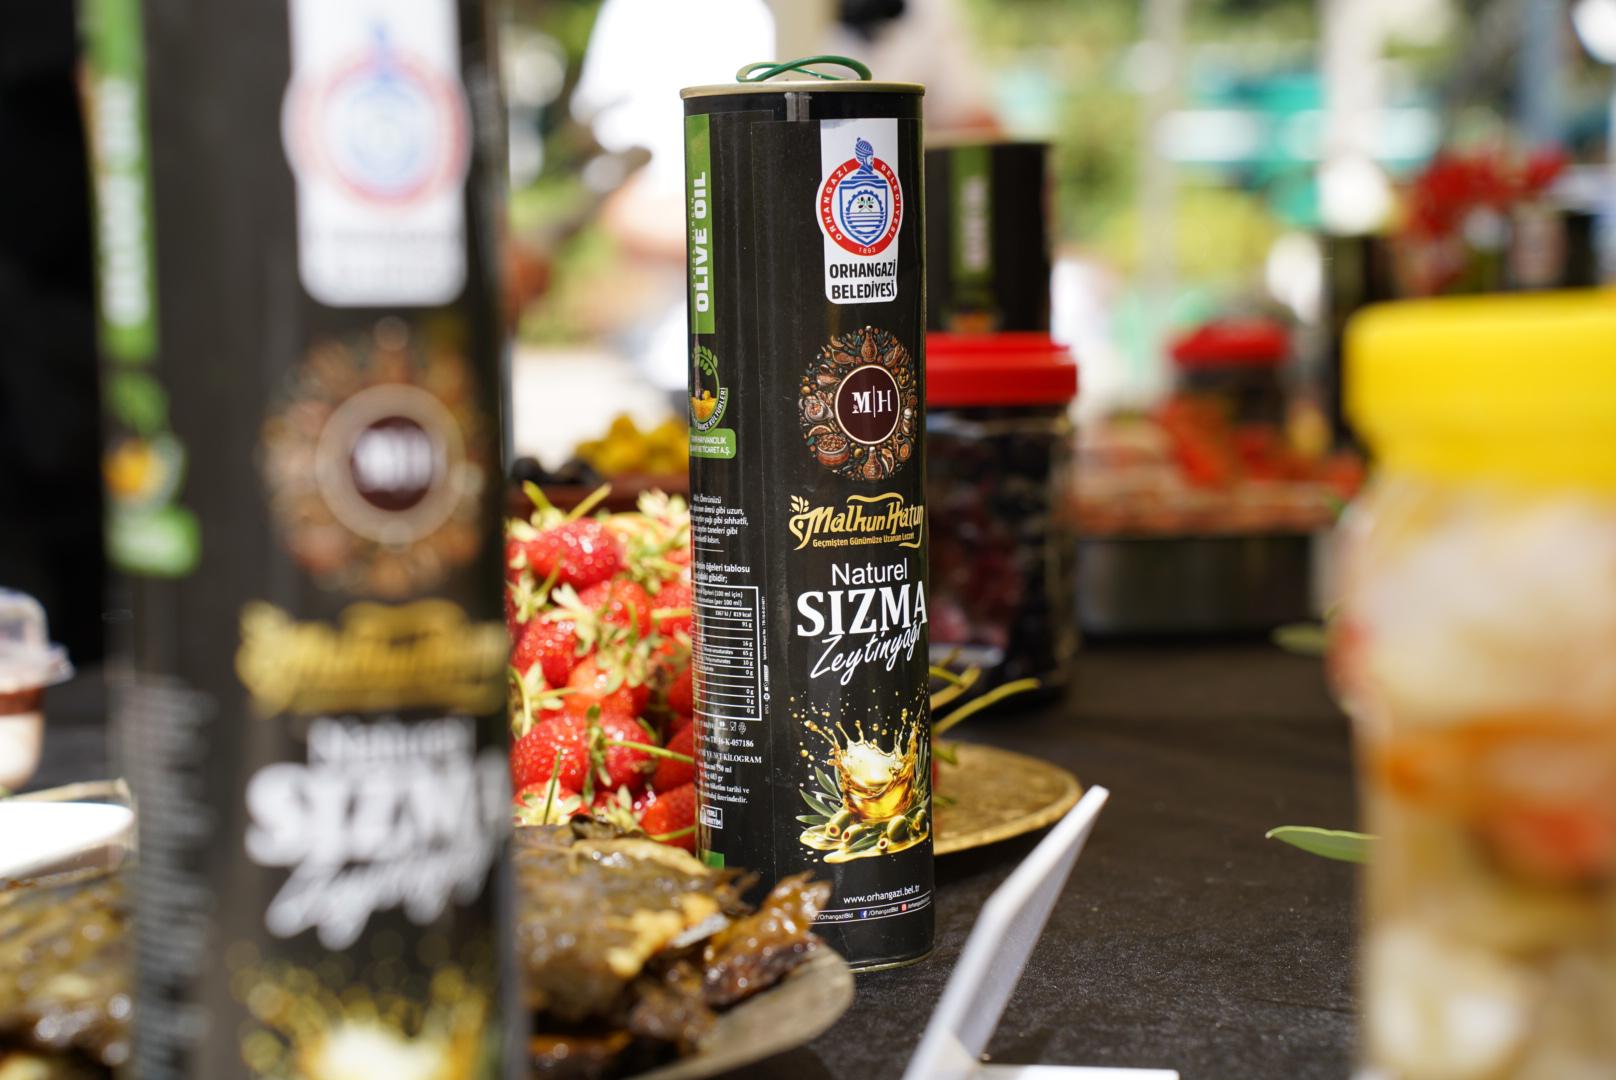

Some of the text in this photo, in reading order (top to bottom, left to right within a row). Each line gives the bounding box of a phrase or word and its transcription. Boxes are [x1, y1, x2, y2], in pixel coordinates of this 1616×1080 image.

[694, 171, 709, 313] OLIVE OIL
[829, 259, 896, 279] ORHANGAZİ
[831, 279, 896, 300] BELEDİYESİ
[726, 508, 744, 516] uzun,
[726, 527, 738, 537] gibi
[812, 538, 848, 549] Geçmişten
[849, 536, 883, 546] Günümüze
[724, 563, 751, 573] tablosu
[831, 557, 908, 586] Naturel
[796, 580, 928, 637] SIZMA
[809, 617, 923, 686] Zeytinyağı
[723, 752, 762, 764] KİLOGRAM
[726, 785, 742, 793] tarihi
[843, 884, 920, 904] www.orhangazi.bel.tr
